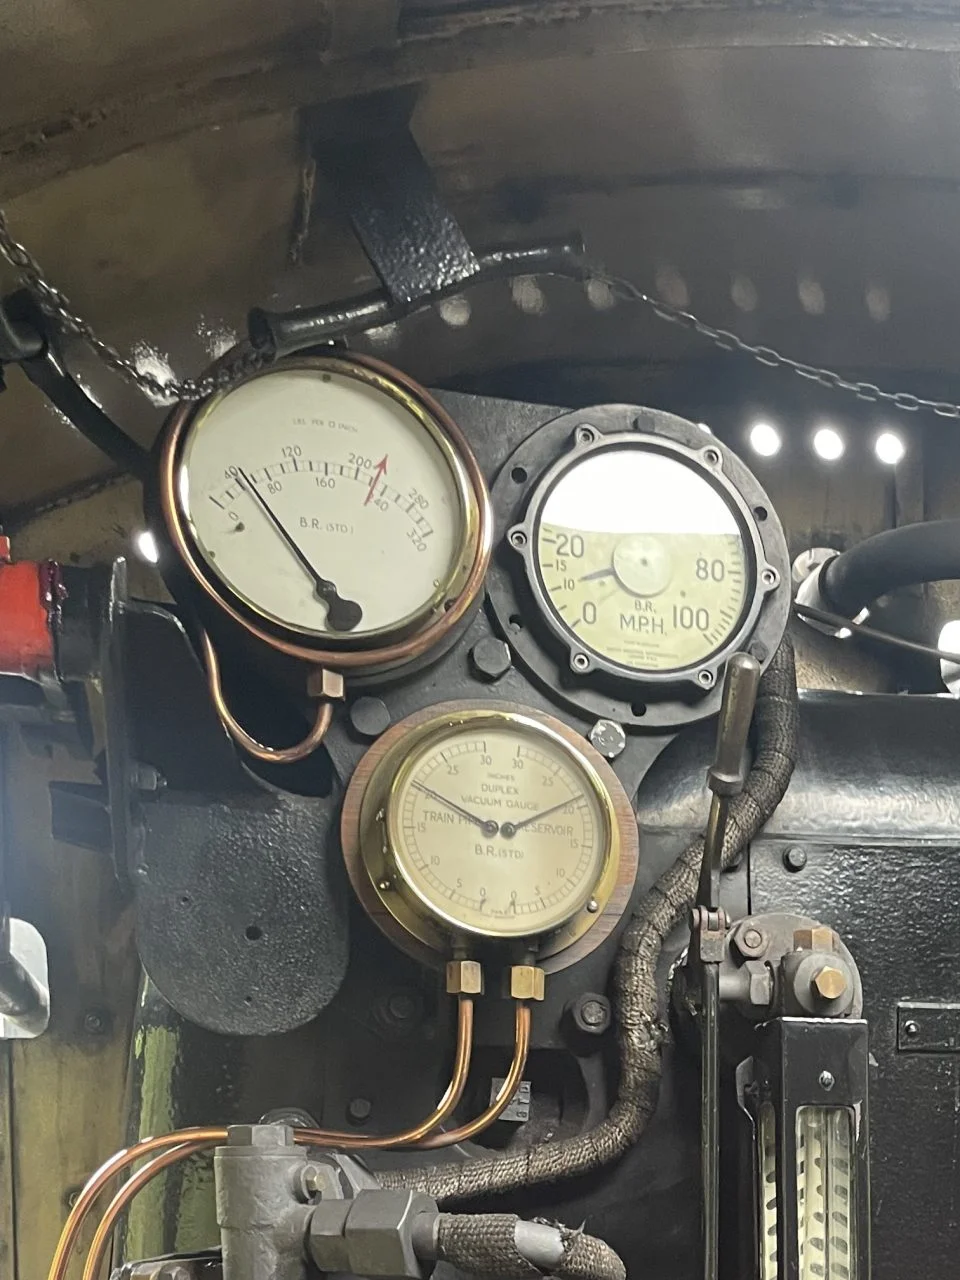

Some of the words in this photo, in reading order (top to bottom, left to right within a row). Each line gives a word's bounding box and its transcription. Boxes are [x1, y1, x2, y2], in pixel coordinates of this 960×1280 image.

[281, 445, 302, 458] 120
[348, 453, 372, 469] 200
[224, 466, 238, 481] 40
[267, 482, 282, 495] 80
[315, 477, 336, 490] 160
[408, 487, 429, 510] 280
[228, 511, 239, 522] 0
[300, 517, 322, 529] B.R.
[406, 527, 428, 552] 320
[555, 534, 585, 559] 20
[555, 560, 567, 572] 15
[695, 559, 726, 583] 80
[563, 580, 575, 591] 10
[634, 601, 657, 613] B.R.
[582, 602, 597, 625] 0
[672, 606, 710, 632] 100
[619, 613, 668, 636] M.P.H.
[480, 754, 492, 766] 30
[512, 758, 524, 769] 30
[447, 764, 459, 776] 25
[542, 775, 554, 787] 25
[481, 783, 519, 795] DUPLEX
[461, 795, 502, 807] VACUUM
[506, 798, 539, 811] GAUGE
[422, 811, 454, 825] TRAIN
[416, 822, 426, 833] 15
[474, 843, 498, 857] B.R.
[570, 839, 579, 849] 15
[430, 855, 440, 866] 10
[556, 868, 565, 877] 10
[456, 878, 463, 889] 5
[480, 887, 486, 897] 0
[511, 890, 517, 900] 0
[534, 885, 541, 896] 5
